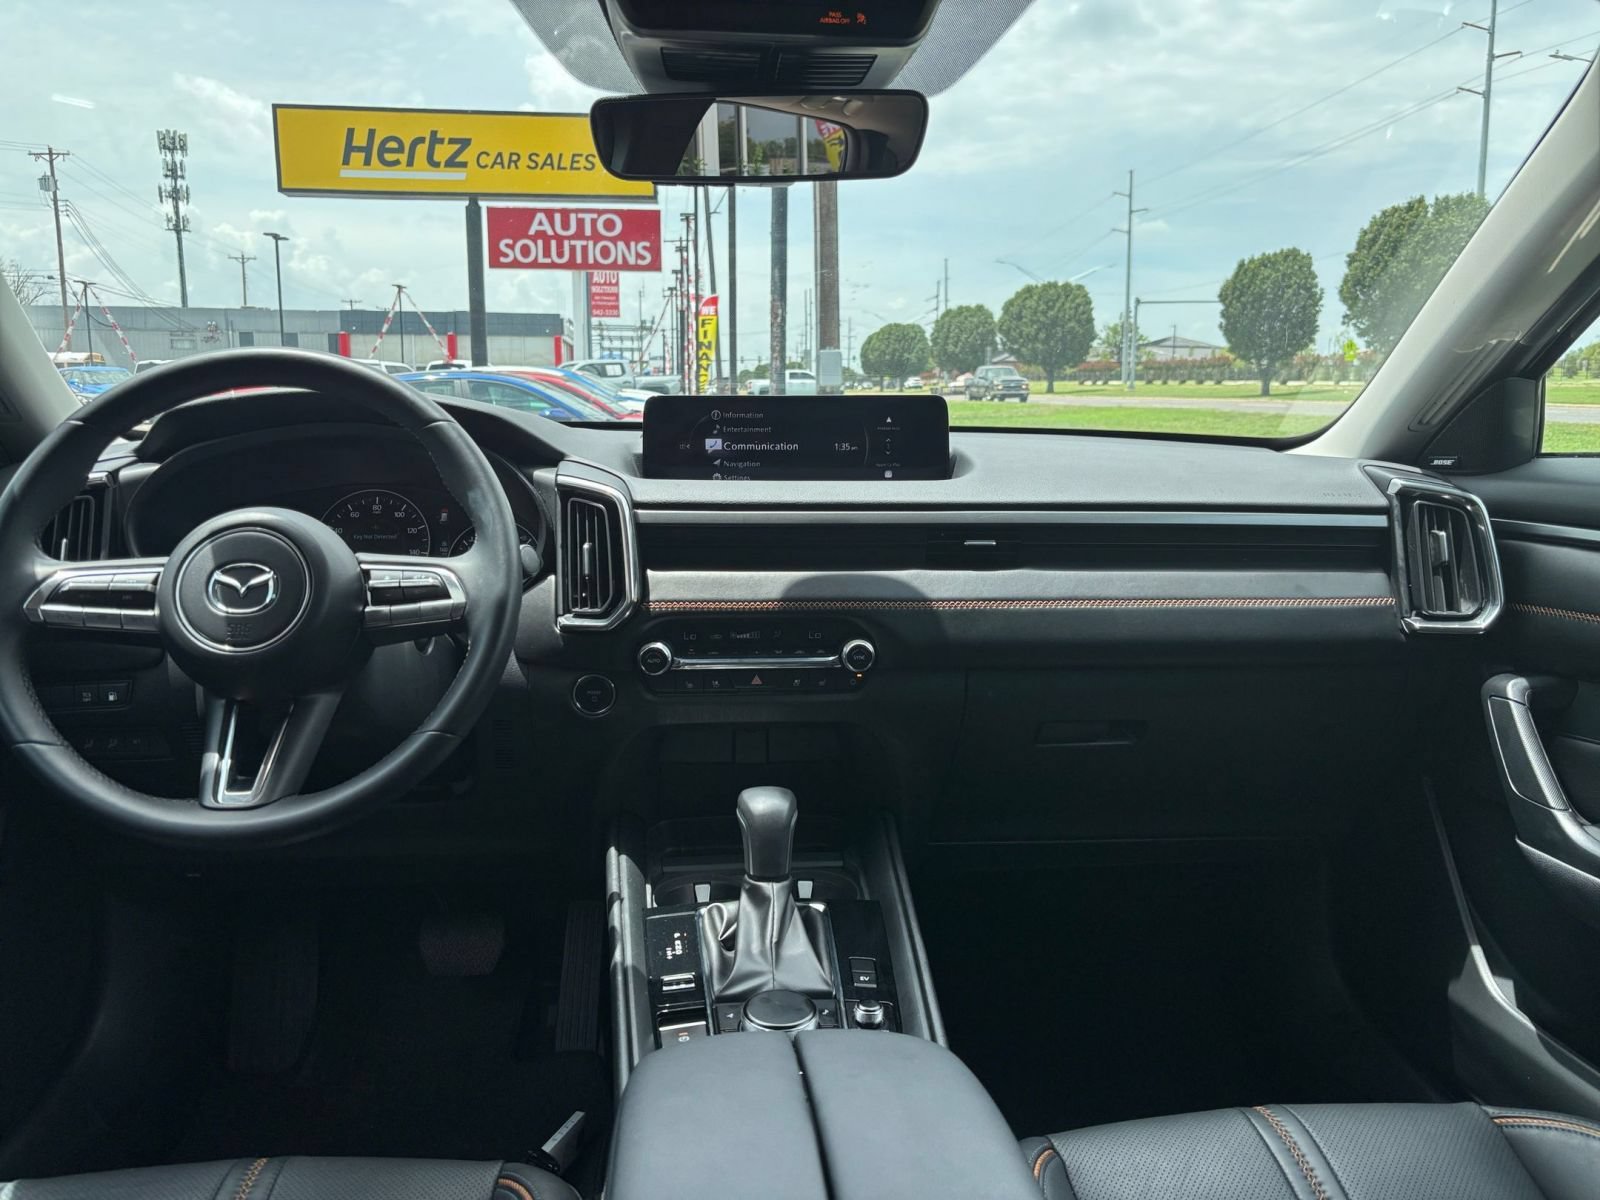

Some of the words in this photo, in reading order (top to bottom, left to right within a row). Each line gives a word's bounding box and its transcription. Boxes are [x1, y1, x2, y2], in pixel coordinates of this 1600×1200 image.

[341, 127, 473, 169] Hertz
[476, 151, 521, 170] CAR
[526, 152, 597, 171] SALES
[528, 212, 623, 237] AUTO
[499, 238, 652, 266] SOLUTIONS
[701, 305, 717, 315] WE
[722, 411, 764, 419] Information
[723, 425, 772, 433] Entertainment
[723, 441, 799, 451] Communication
[723, 460, 761, 468] Navigation
